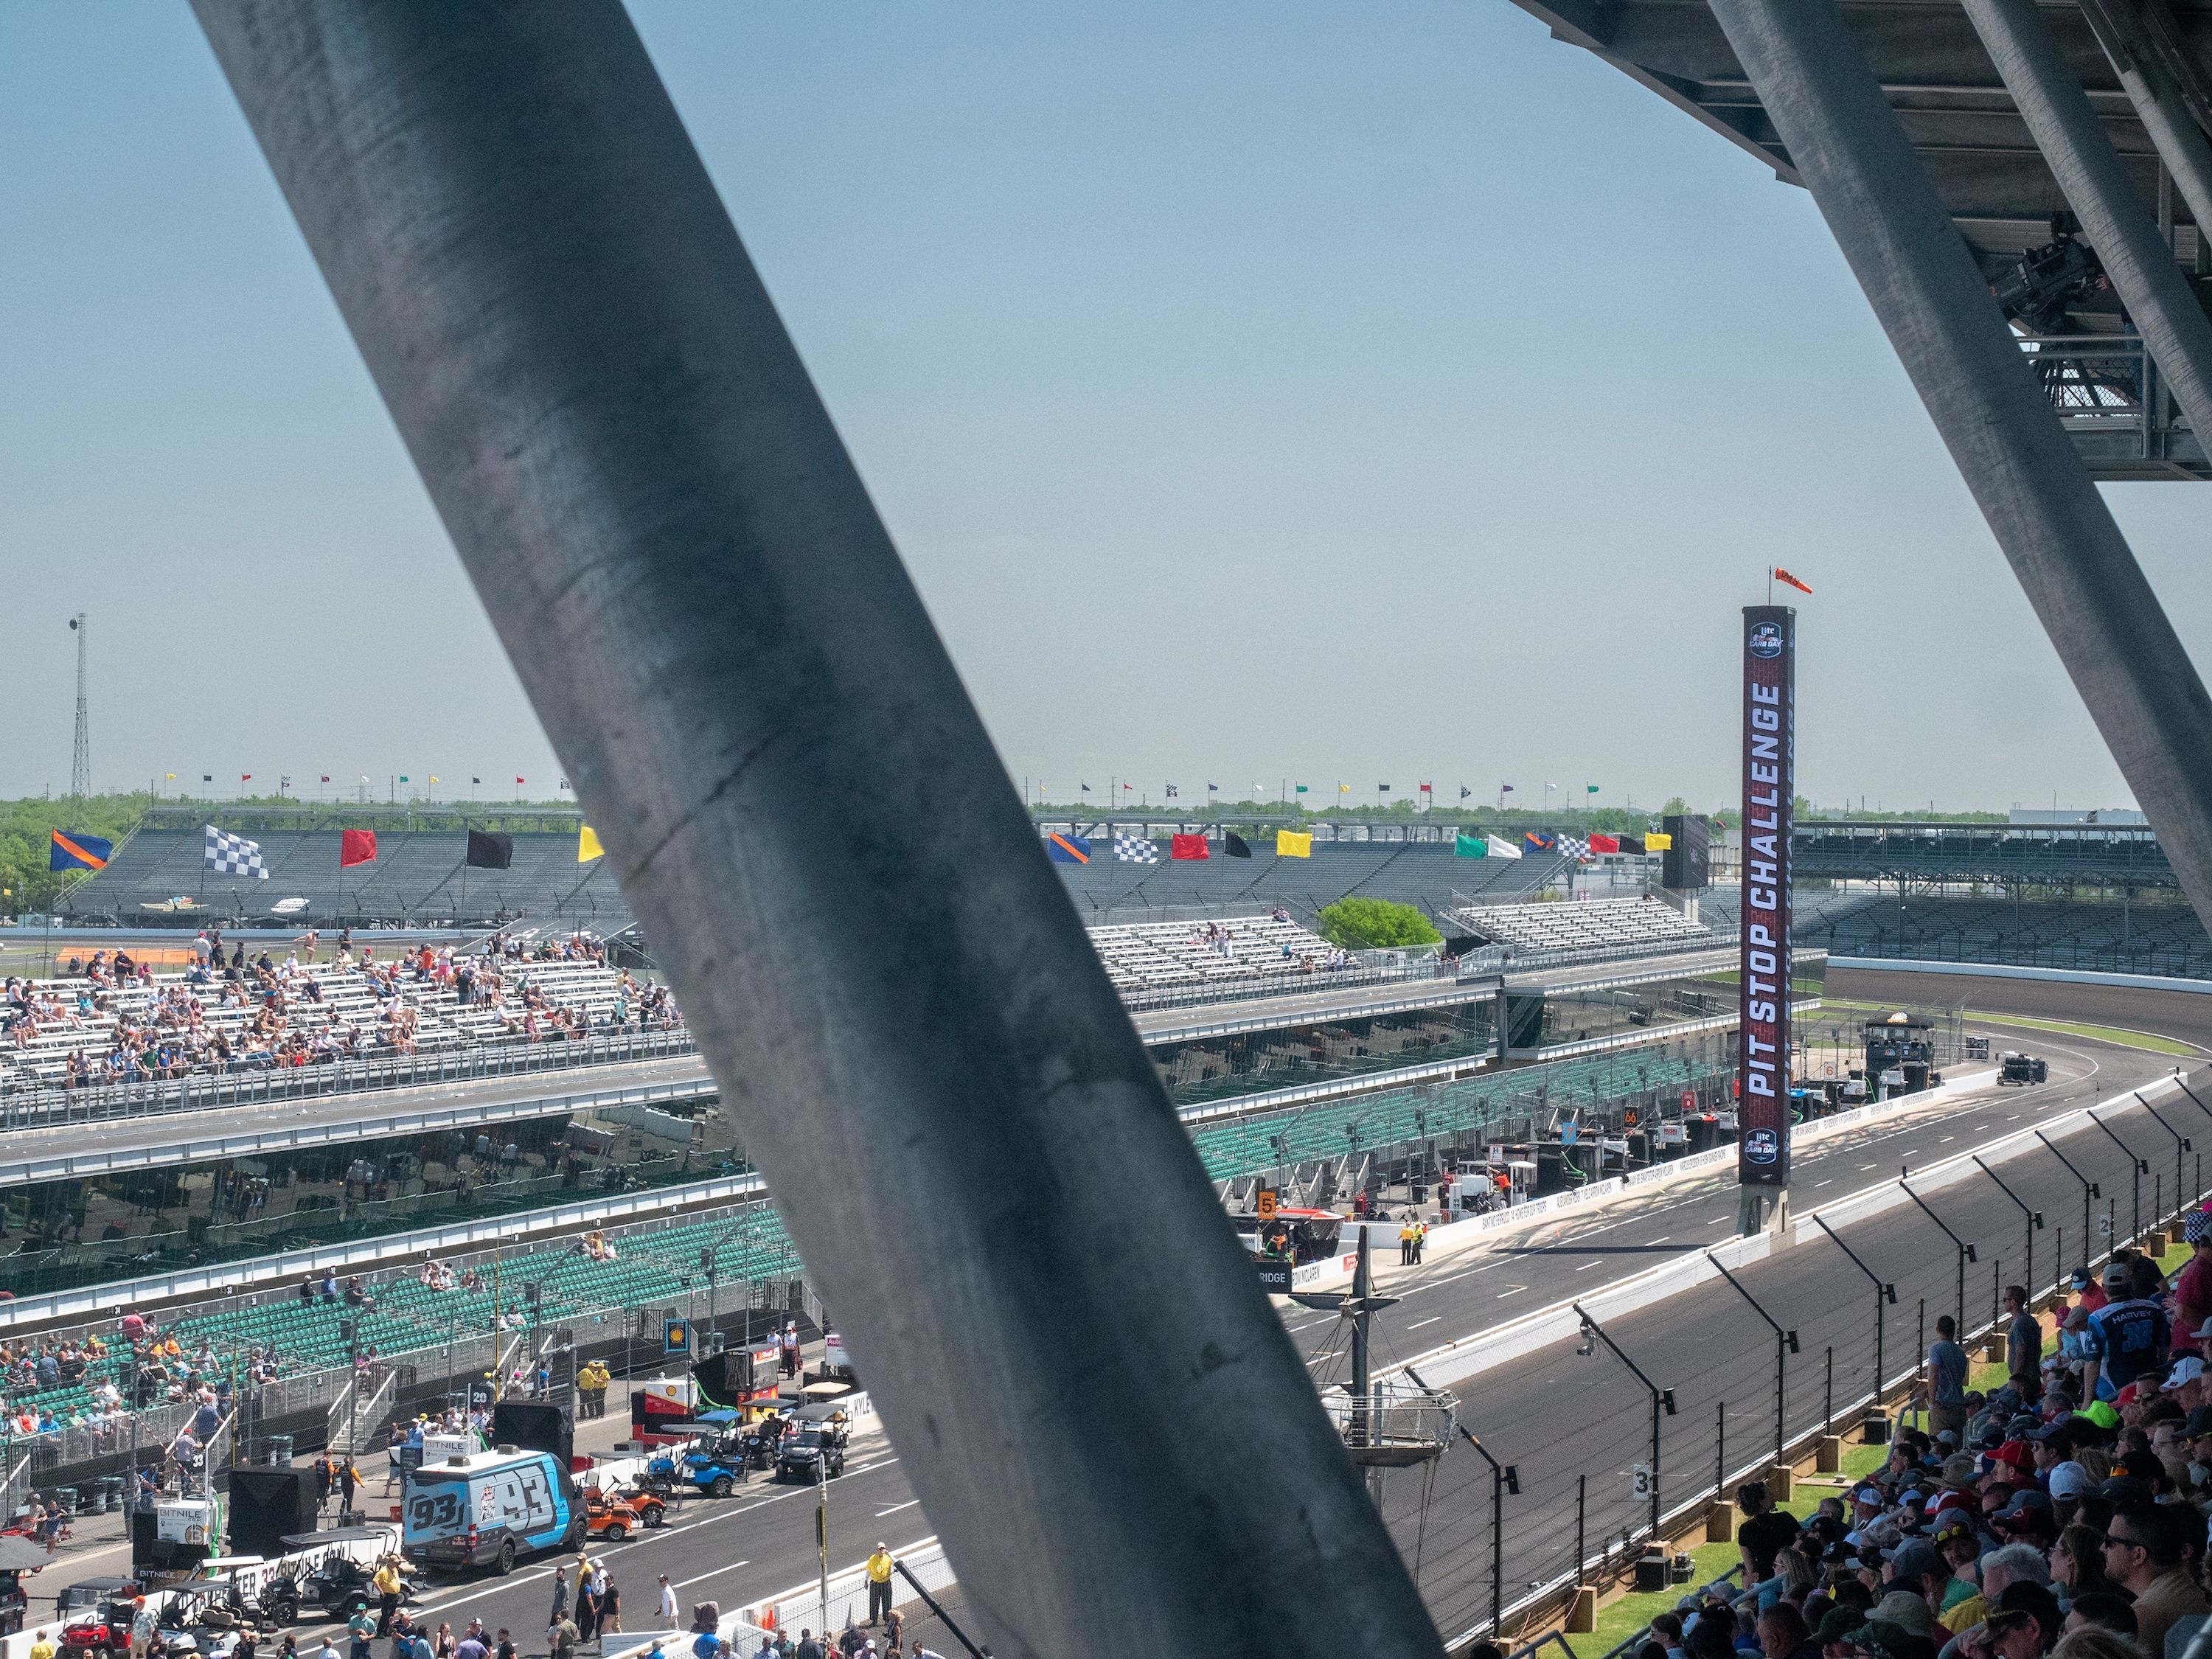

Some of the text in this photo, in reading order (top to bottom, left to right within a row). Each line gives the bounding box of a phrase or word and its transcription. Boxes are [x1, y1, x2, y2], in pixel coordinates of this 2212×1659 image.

[1761, 627, 1775, 636] Lite
[1748, 683, 1779, 1097] PIT STOP CHALLENGE
[1826, 1066, 1834, 1076] 6
[1625, 1113, 1636, 1123] 66
[1566, 1127, 1574, 1138] 7
[1756, 1133, 1770, 1142] Lite
[1262, 1198, 1272, 1213] 5
[2100, 1219, 2109, 1233] 2
[2112, 1310, 2152, 1324] HARVEY
[473, 1391, 487, 1403] 20
[855, 1397, 871, 1417] KYLE
[425, 1441, 464, 1450] BITNILE
[192, 1454, 204, 1467] 33
[1635, 1471, 1649, 1493] 3
[495, 1466, 554, 1532] 93
[159, 1509, 201, 1518] BITNILE
[413, 1492, 458, 1532] 93
[139, 1570, 175, 1579] BITNILE
